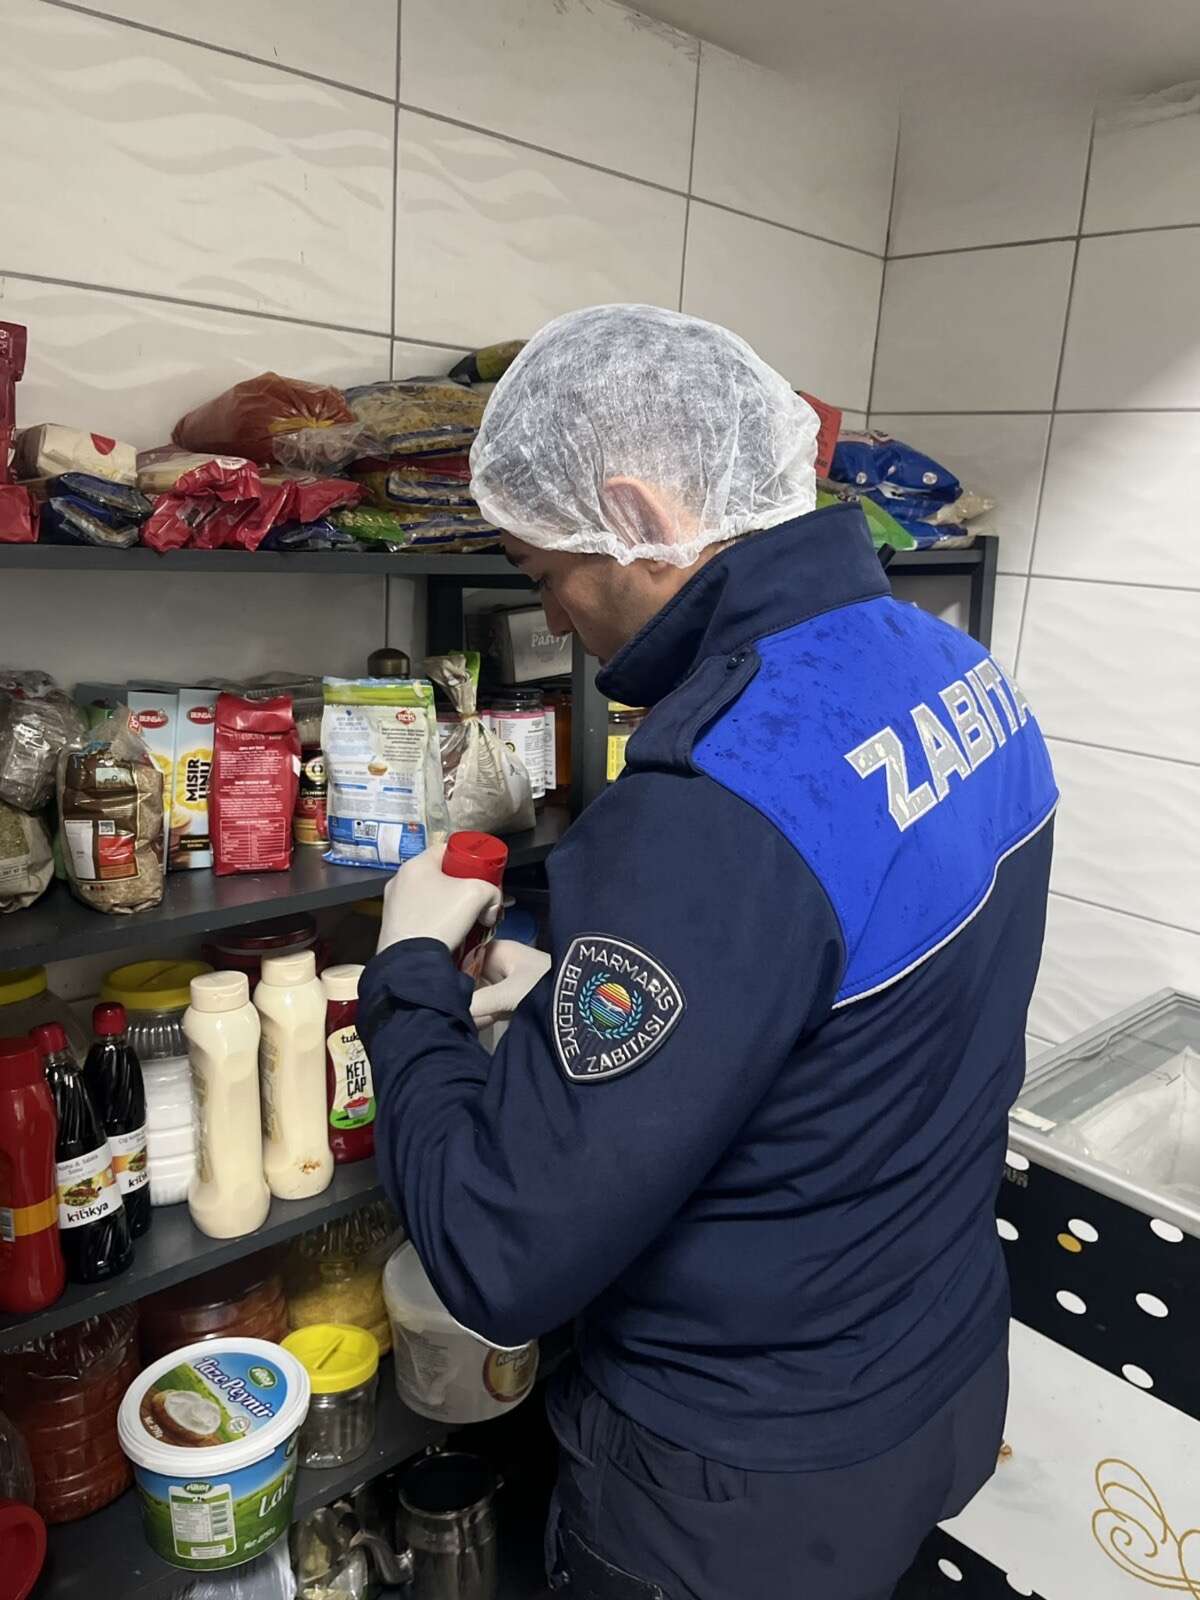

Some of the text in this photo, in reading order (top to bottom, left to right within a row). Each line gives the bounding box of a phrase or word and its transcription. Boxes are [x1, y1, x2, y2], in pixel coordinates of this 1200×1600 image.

[184, 758, 200, 802] MISIR
[578, 943, 675, 1012] MARMARİS
[341, 1032, 361, 1044] tuk
[586, 1013, 666, 1073] ZABITASI
[346, 1060, 366, 1081] KET
[346, 1076, 367, 1099] ÇAP
[67, 1202, 109, 1222] kilikya
[194, 1356, 229, 1385] Taze
[220, 1377, 275, 1418] Peynir
